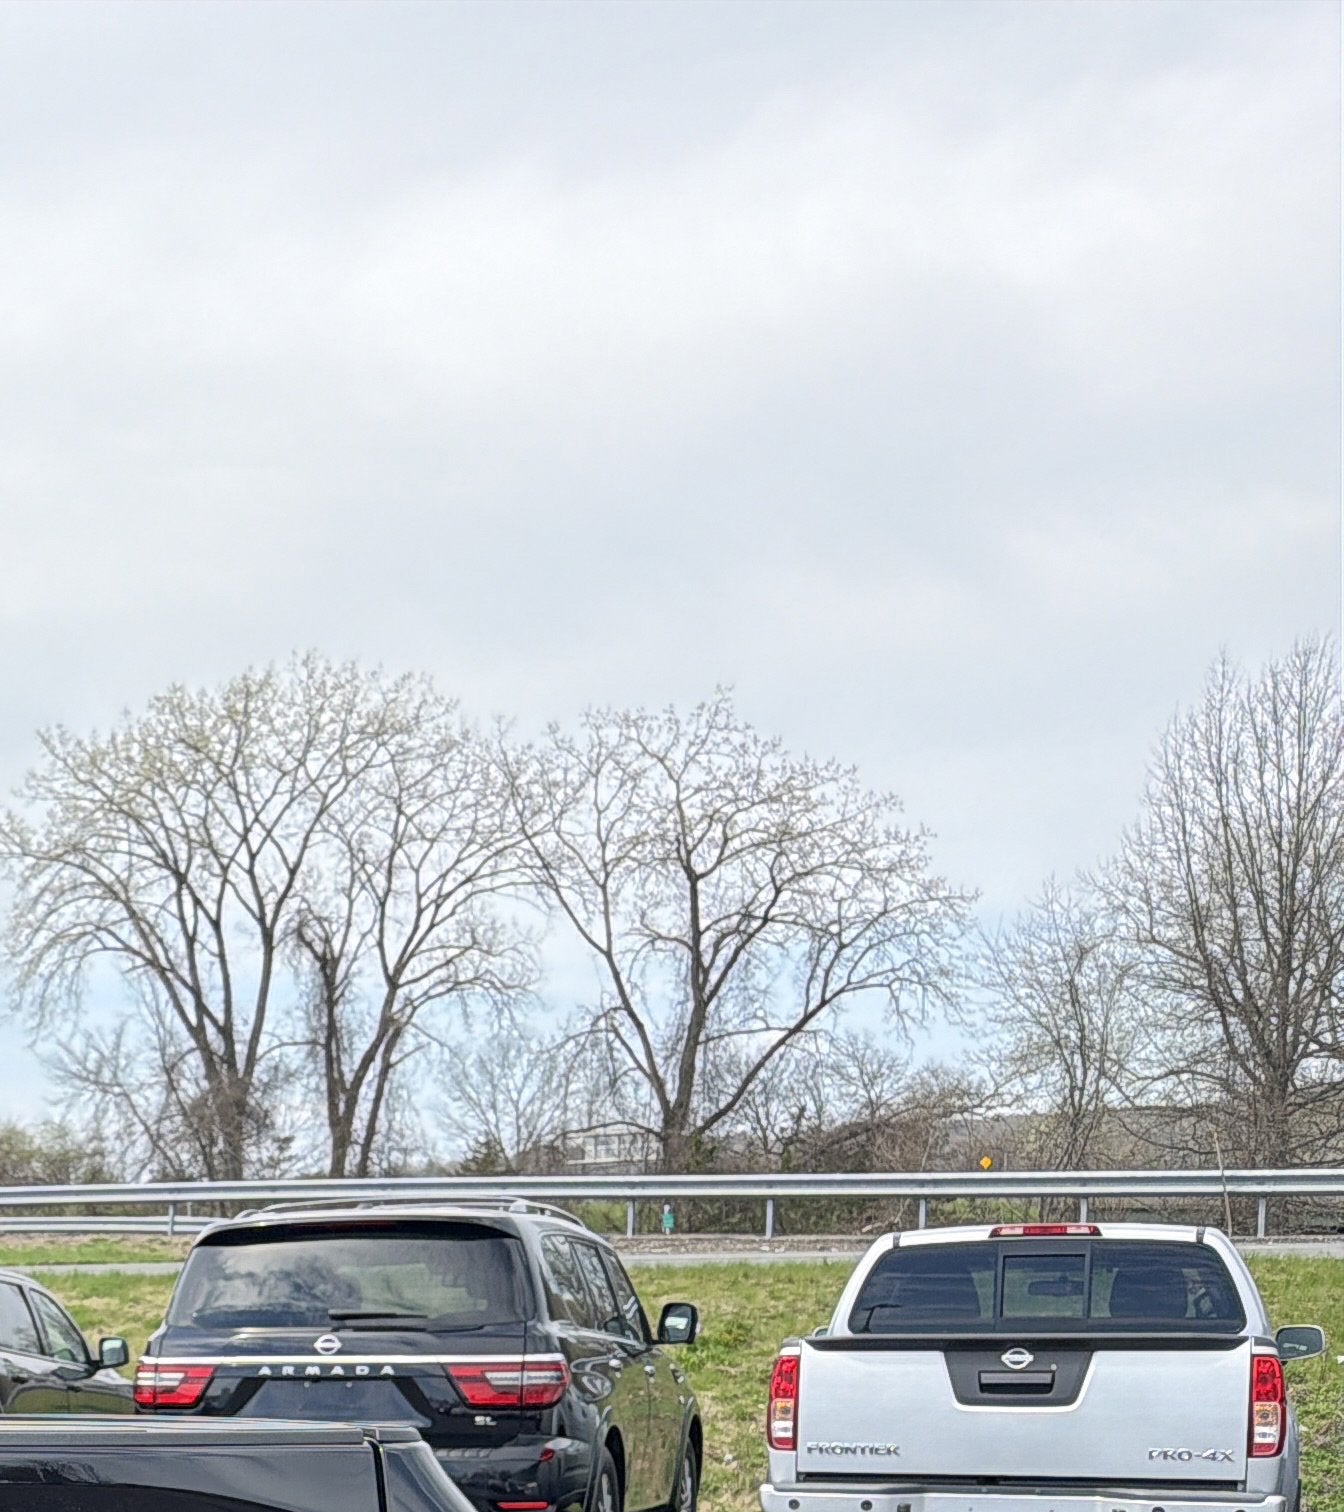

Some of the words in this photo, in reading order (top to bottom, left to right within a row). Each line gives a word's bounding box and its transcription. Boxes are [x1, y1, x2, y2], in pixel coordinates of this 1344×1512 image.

[257, 1365, 395, 1376] ARMADA
[806, 1442, 900, 1456] FRONTIER
[1147, 1448, 1234, 1462] PRO-4X
